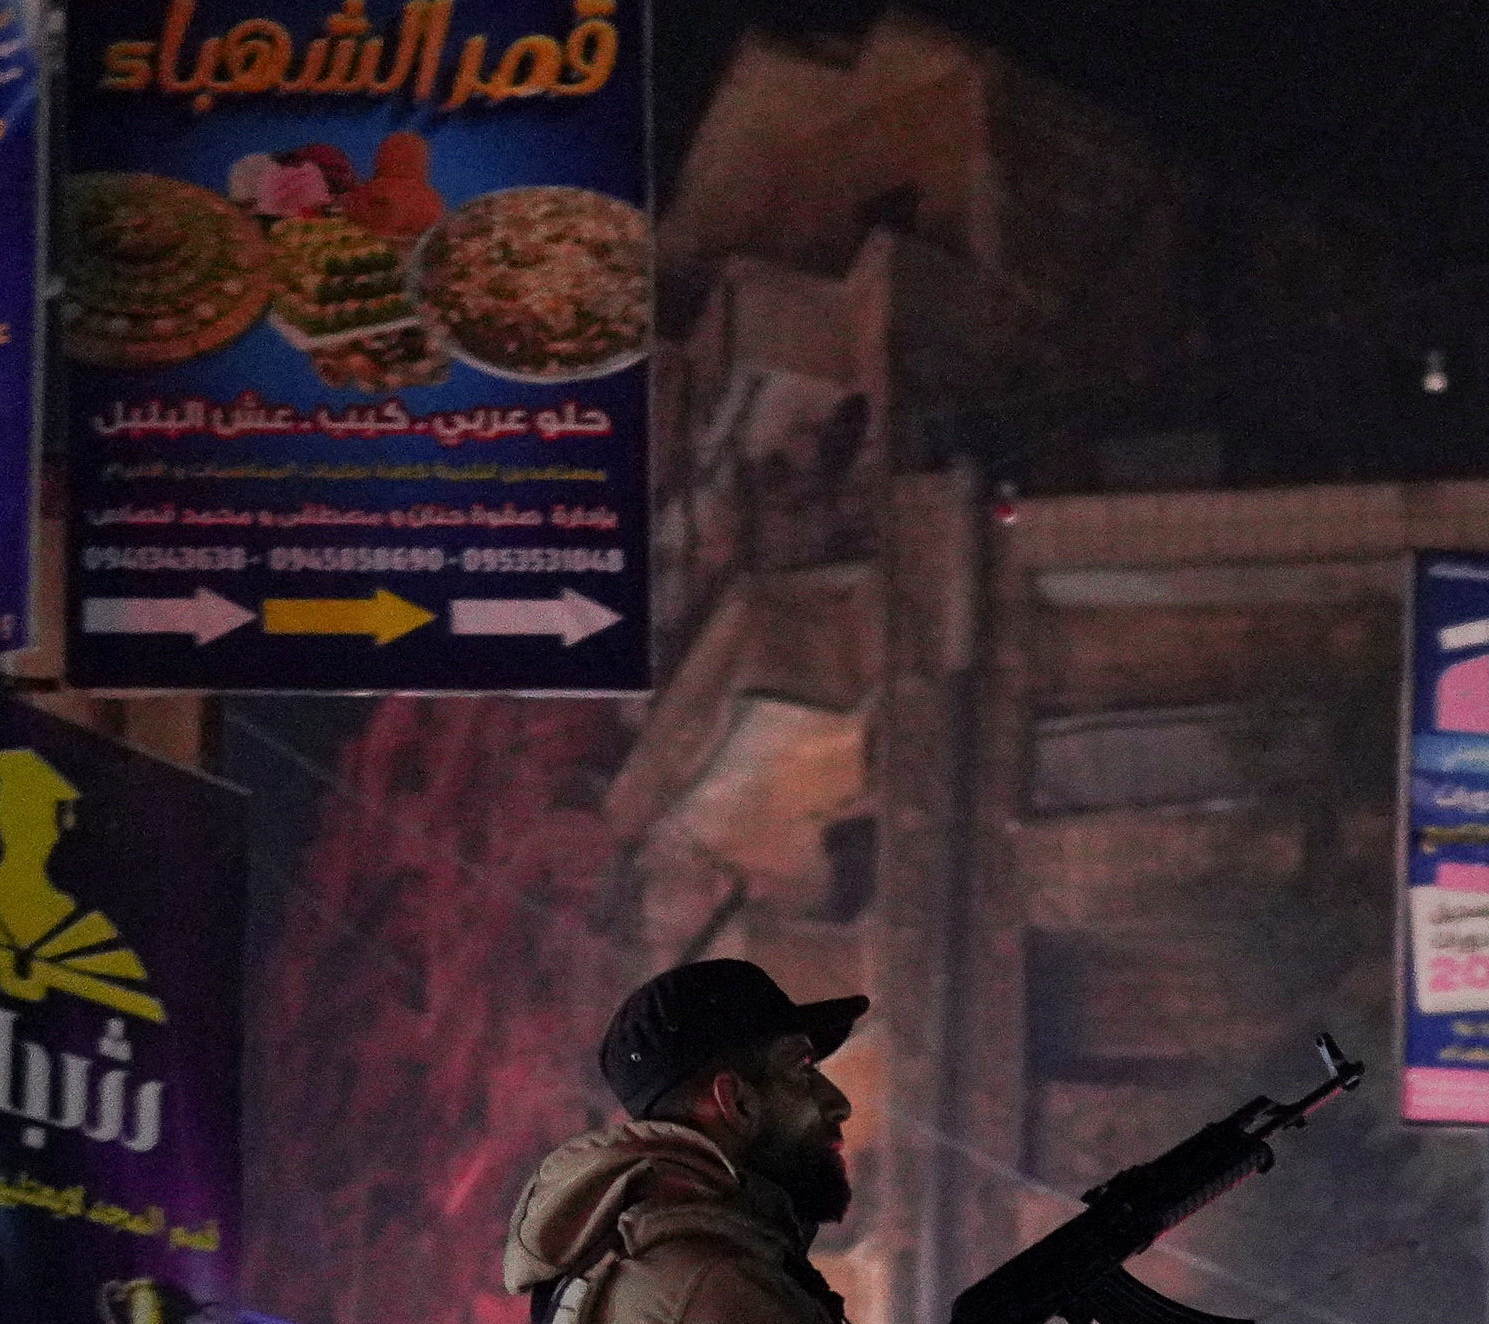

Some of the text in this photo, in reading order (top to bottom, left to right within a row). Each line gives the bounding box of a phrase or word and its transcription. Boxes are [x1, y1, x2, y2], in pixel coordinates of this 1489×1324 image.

[99, 0, 453, 113] الشهباء
[441, 0, 619, 111] قمر
[433, 404, 530, 449] عربي
